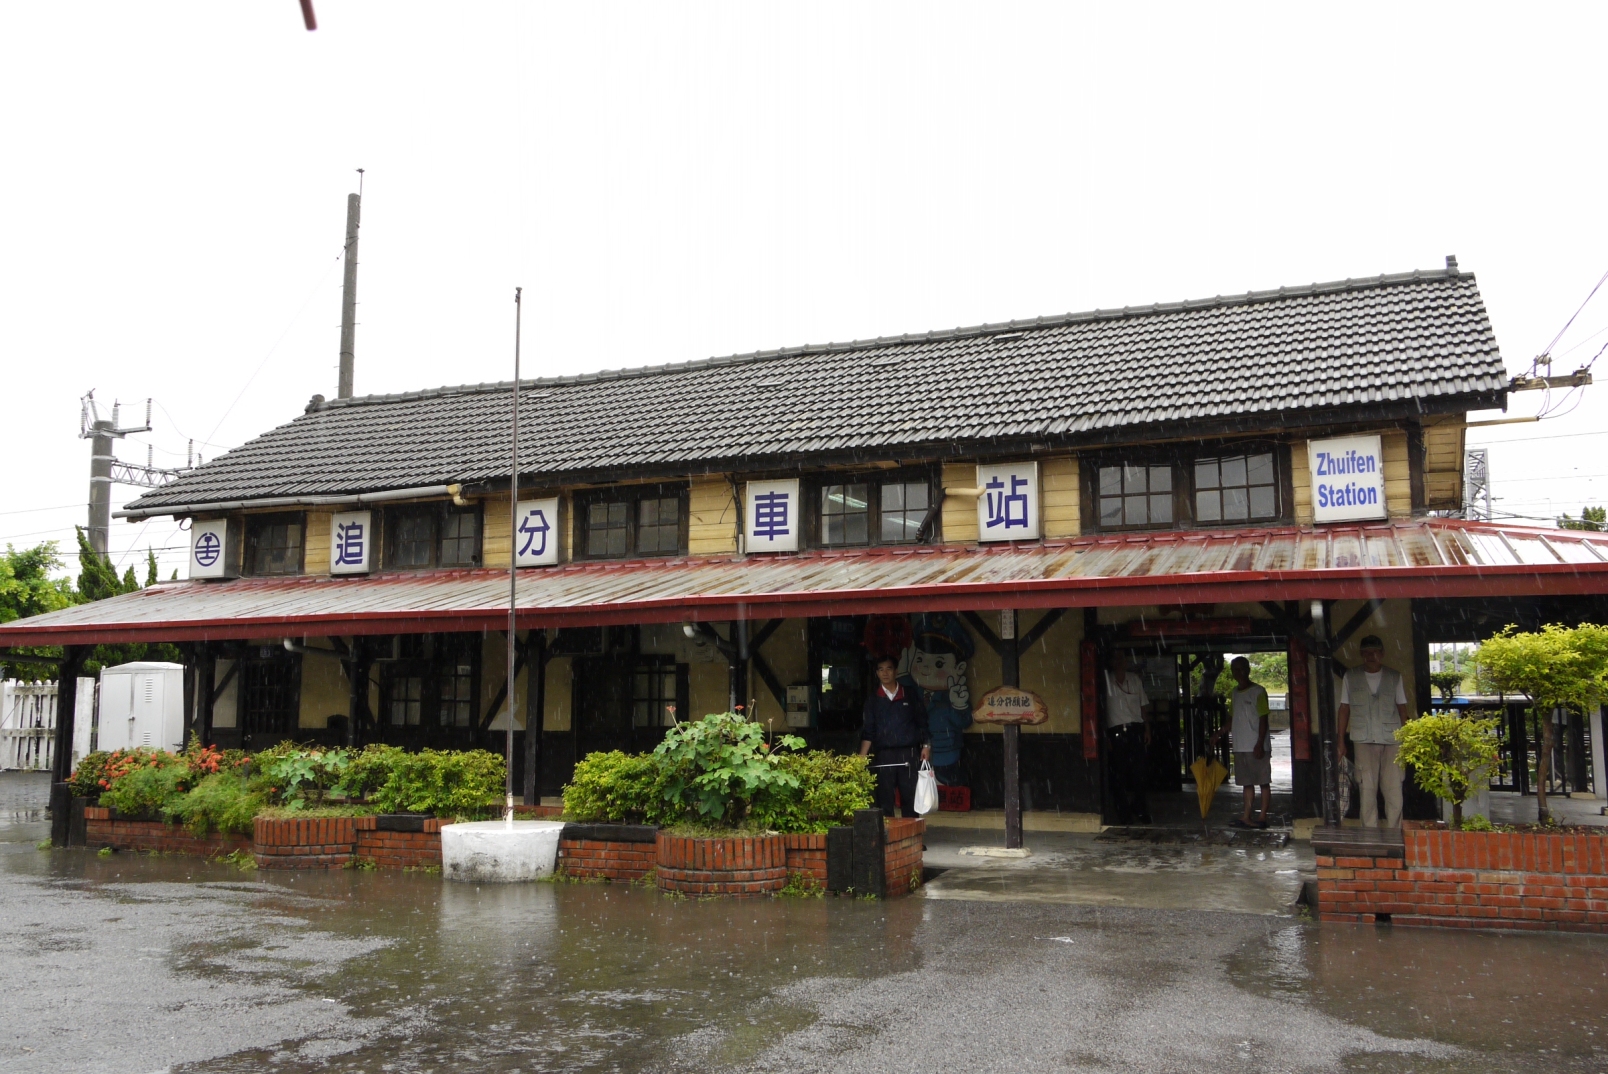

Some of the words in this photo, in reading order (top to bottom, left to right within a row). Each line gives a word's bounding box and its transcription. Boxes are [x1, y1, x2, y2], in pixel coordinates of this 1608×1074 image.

[1316, 450, 1376, 476] Zhuifen
[1318, 482, 1377, 508] Station
[335, 521, 363, 566] 追
[518, 509, 550, 557] 分
[753, 491, 790, 542] 車
[986, 474, 1029, 529] 站
